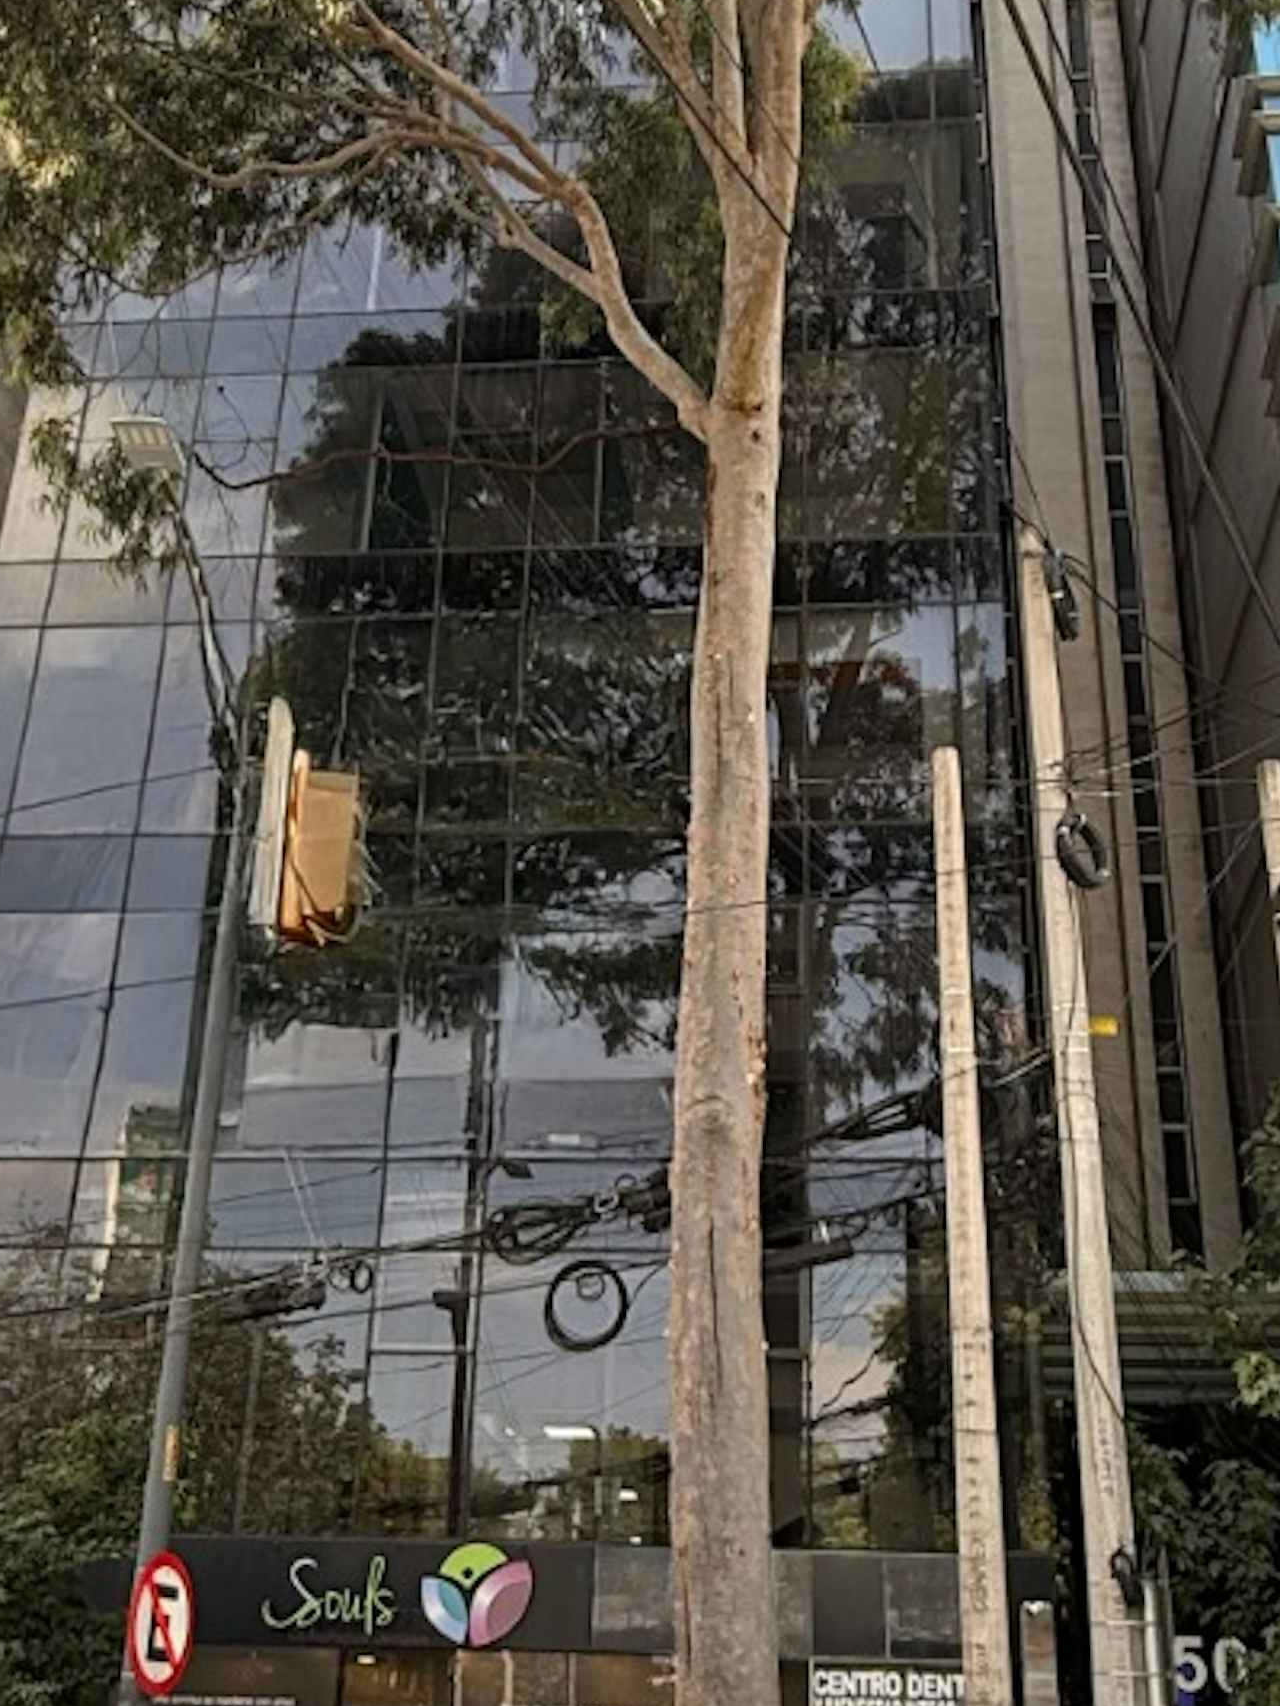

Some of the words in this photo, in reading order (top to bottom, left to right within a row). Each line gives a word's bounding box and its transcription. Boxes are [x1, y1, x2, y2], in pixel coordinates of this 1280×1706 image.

[261, 1555, 398, 1635] Souls
[815, 1671, 902, 1696] CENTRO
[906, 1673, 967, 1699] DENT
